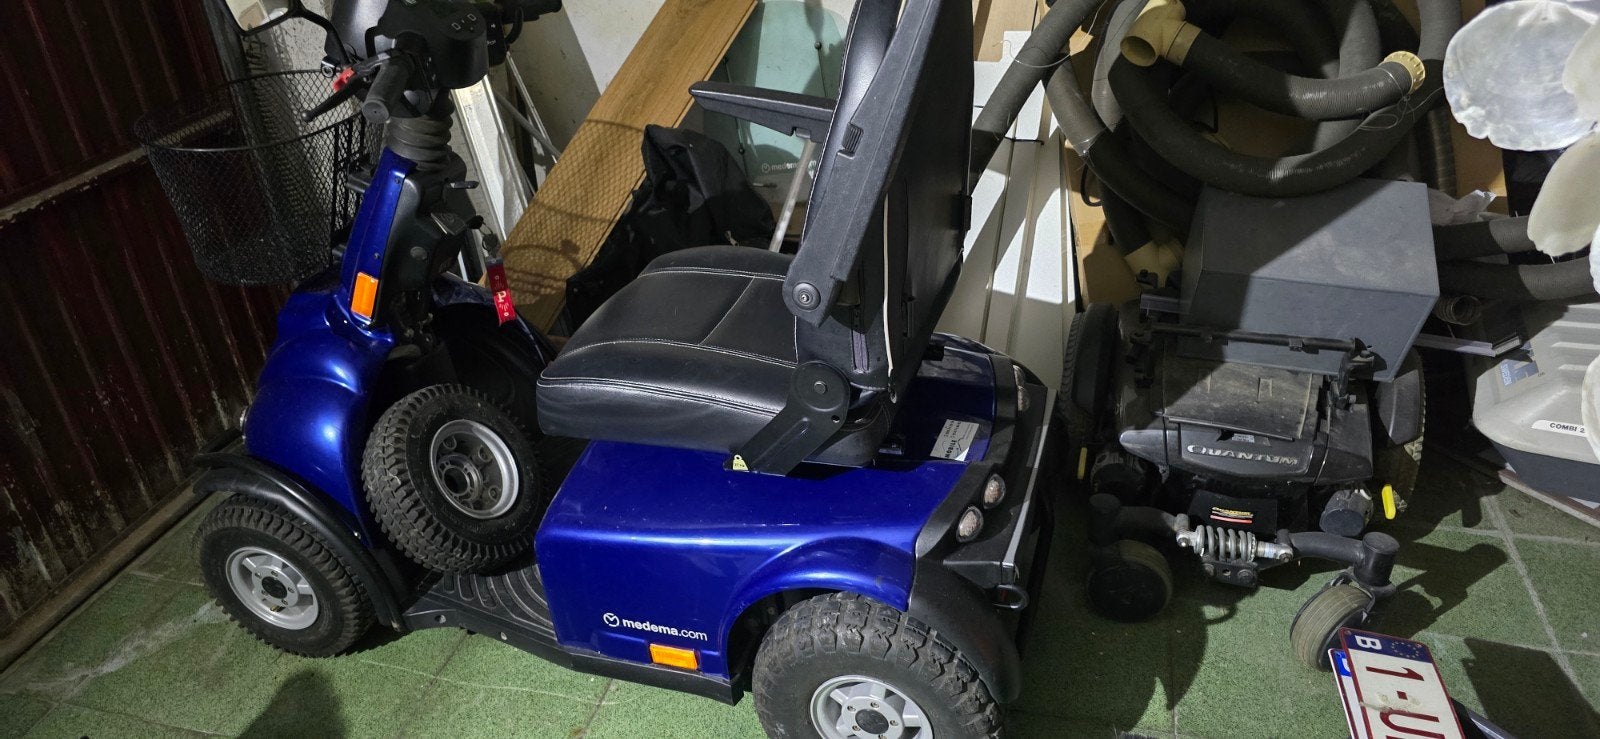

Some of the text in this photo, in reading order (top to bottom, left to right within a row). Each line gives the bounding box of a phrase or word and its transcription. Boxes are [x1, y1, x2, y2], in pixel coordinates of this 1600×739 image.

[1549, 422, 1578, 433] COMBI
[1187, 444, 1299, 465] QUANTUM
[622, 618, 708, 641] medema.com
[1355, 635, 1382, 650] B
[1365, 666, 1446, 739] 1-U
